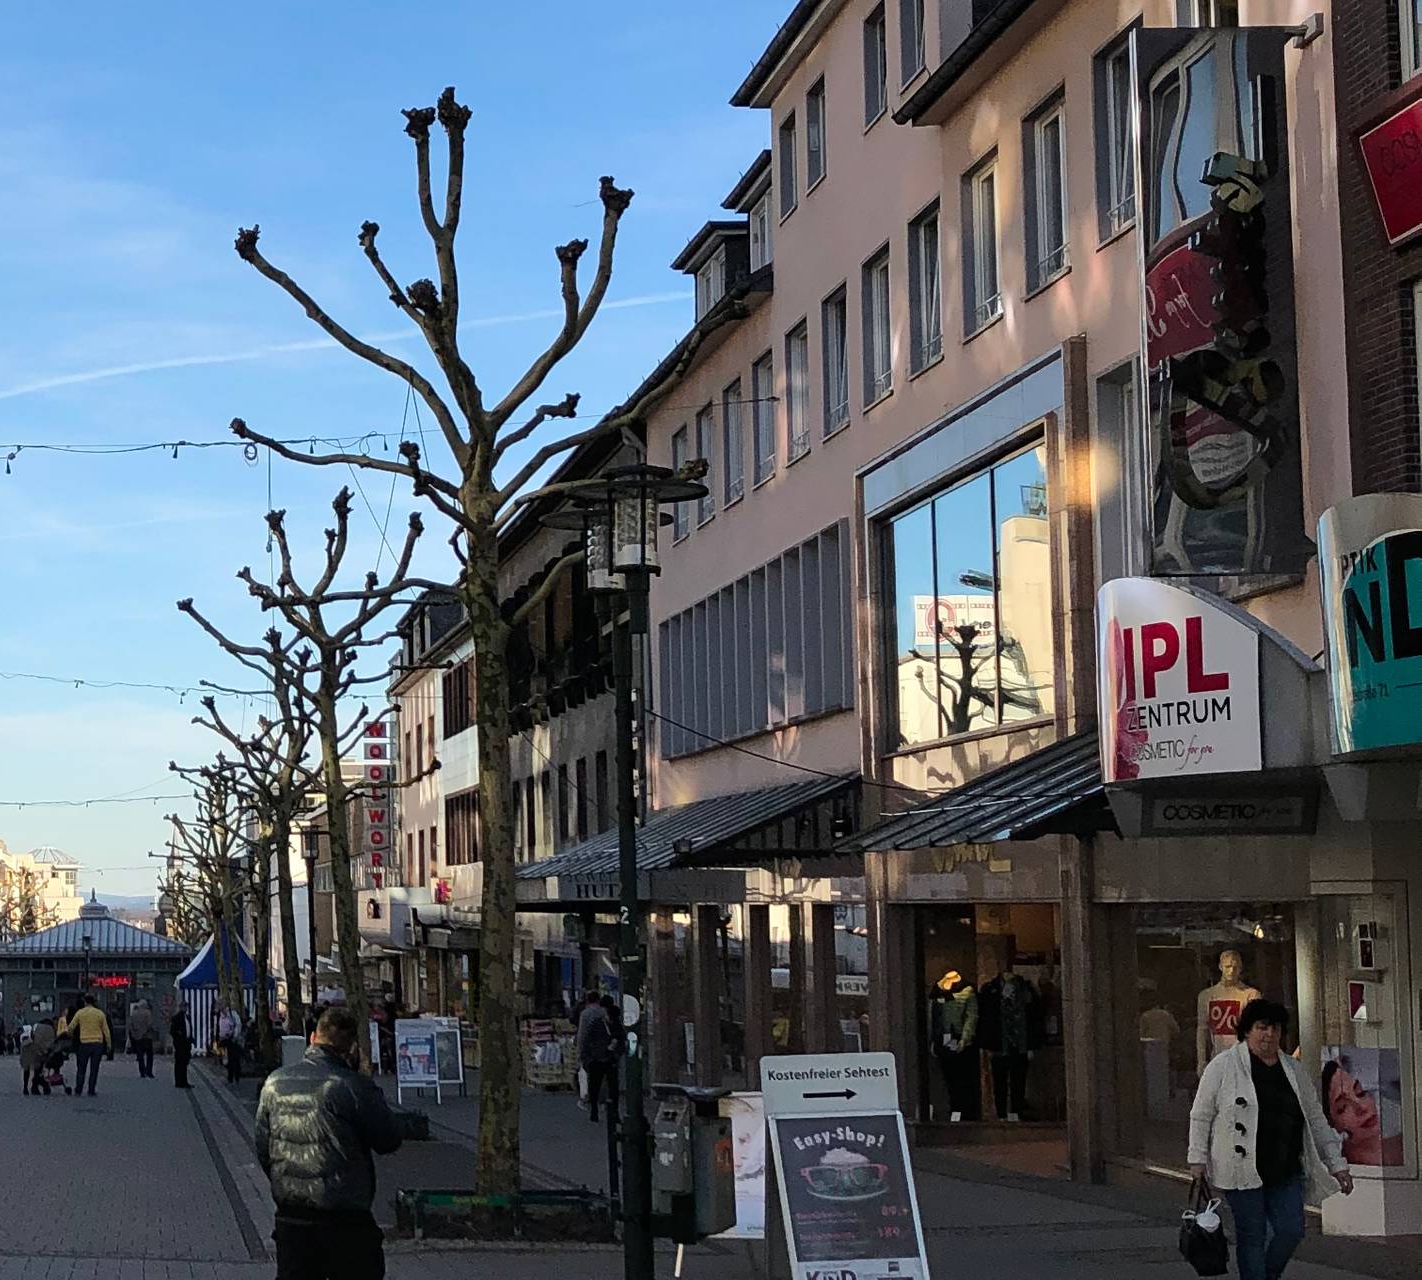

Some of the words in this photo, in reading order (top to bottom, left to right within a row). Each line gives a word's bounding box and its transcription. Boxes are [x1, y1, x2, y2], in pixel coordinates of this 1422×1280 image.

[1123, 616, 1230, 700] IPL
[1127, 696, 1231, 731] ZENTRUM
[1129, 739, 1184, 762] COSMETIC
[1163, 804, 1256, 821] COSMETIC
[767, 1068, 842, 1081] Kostenfreier
[844, 1067, 890, 1078] Sehtest
[792, 1126, 885, 1151] Easy-Shop!
